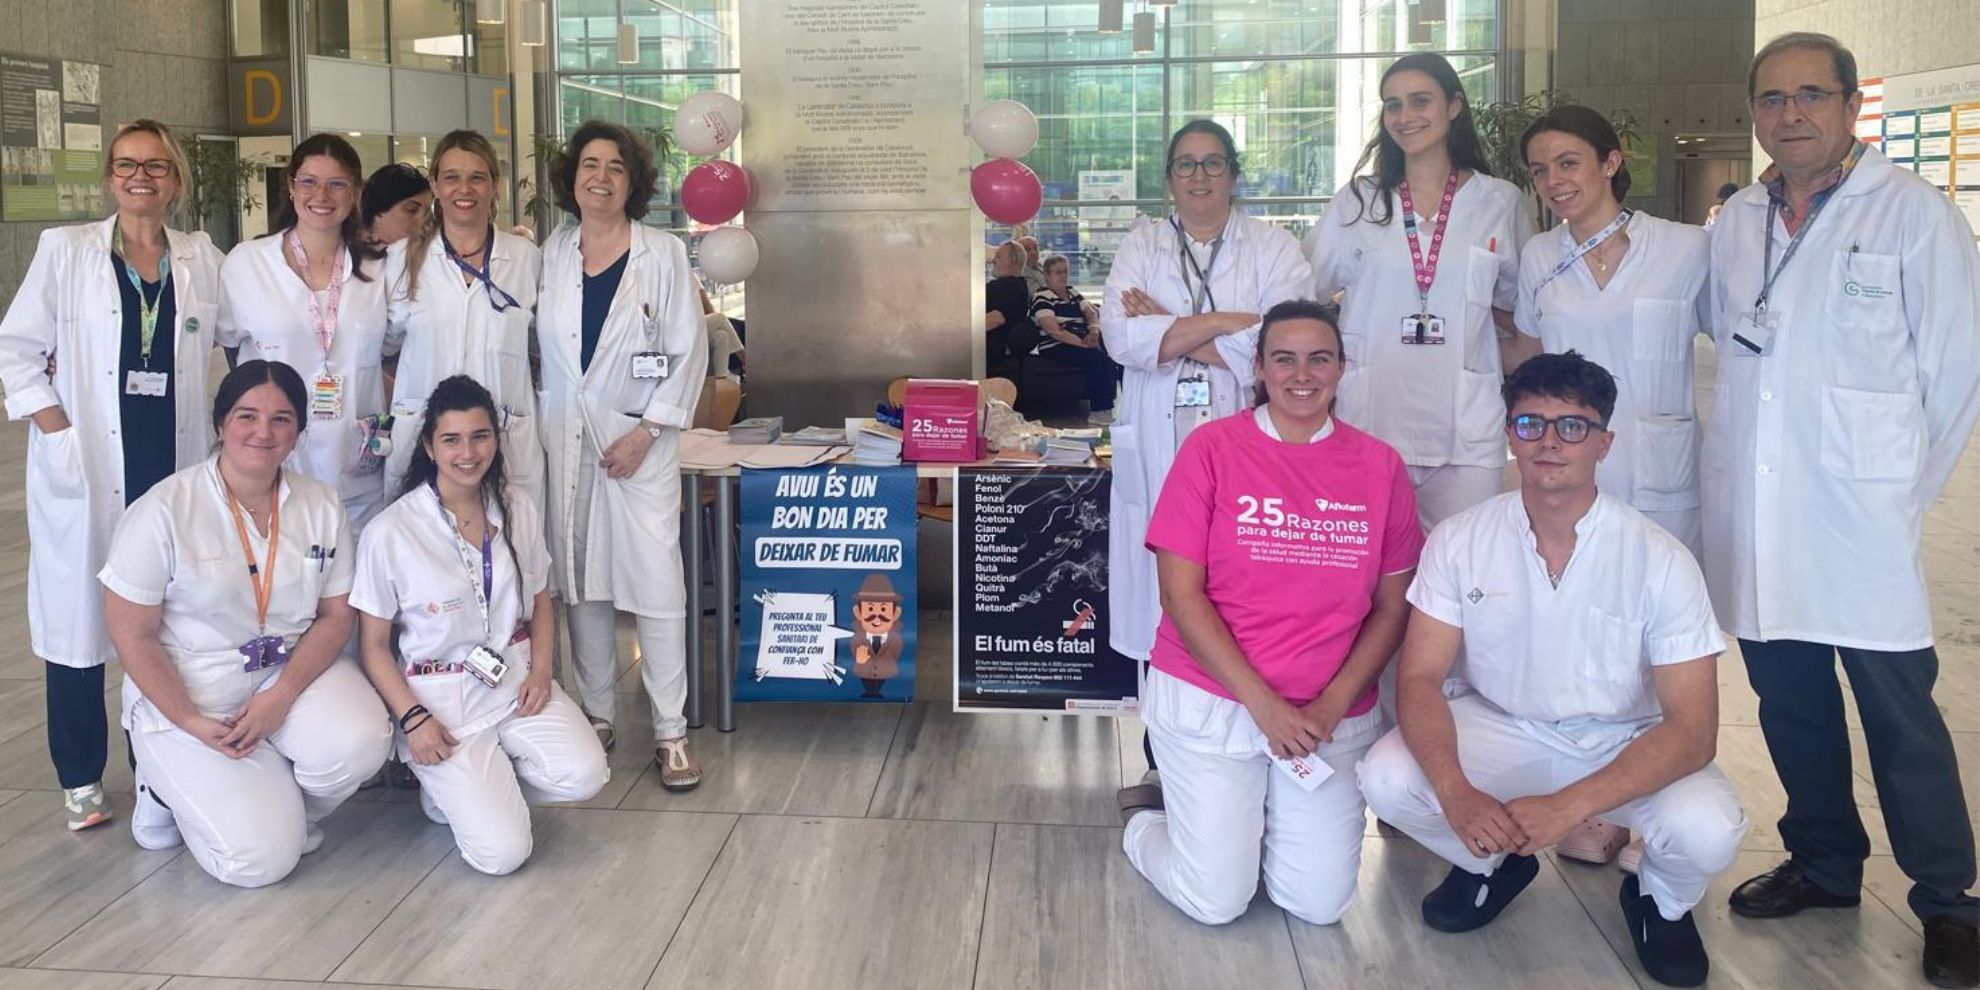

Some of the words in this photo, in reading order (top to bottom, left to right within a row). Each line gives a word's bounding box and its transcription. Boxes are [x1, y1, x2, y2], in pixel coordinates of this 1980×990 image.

[244, 68, 282, 126] D
[912, 418, 933, 432] 25
[933, 425, 968, 434] Razones
[776, 475, 820, 498] AVUI
[824, 467, 847, 498] ÉS
[850, 474, 878, 497] UN
[975, 474, 1012, 484] Arsènic
[975, 484, 1002, 493] Fenol
[975, 504, 1005, 513] Poloni
[1007, 504, 1024, 514] 210
[1237, 495, 1285, 527] 25
[771, 506, 814, 529] BON
[816, 507, 848, 529] DIA
[852, 507, 888, 529] PER
[975, 515, 1015, 524] Acetona
[1286, 513, 1369, 533] Razones
[975, 524, 1007, 533] Cianur
[975, 534, 996, 543] DDT
[1237, 526, 1267, 536] para
[1271, 528, 1305, 541] dejar
[1310, 531, 1326, 542] de
[1330, 533, 1369, 545] fumar
[975, 544, 1018, 553] Naftalina
[1271, 541, 1310, 550] informativa
[1311, 544, 1327, 552] para
[759, 542, 817, 562] DEIXAR
[819, 543, 840, 562] DE
[843, 544, 900, 563] FUMAR
[1269, 548, 1287, 556] salud
[1289, 549, 1322, 558] mediante
[975, 554, 1018, 563] Amoniac
[1299, 557, 1321, 567] ayuda
[1321, 559, 1358, 569] profesional
[975, 564, 998, 573] Butà
[975, 573, 1015, 583] Nicotina
[975, 583, 1005, 593] Quitrà
[975, 593, 1000, 602] Plom
[975, 603, 1015, 613] Metanol
[769, 612, 804, 621] PREGUNTA
[805, 612, 814, 621] AL
[815, 612, 827, 621] TEU
[773, 623, 822, 632] PROFESSIONAL
[777, 635, 809, 643] SANITARI
[809, 635, 818, 643] DE
[975, 635, 992, 651] El
[995, 635, 1030, 651] fum
[1033, 635, 1054, 653] és
[1057, 638, 1095, 654] fatal
[768, 645, 805, 656] CONFIANÇA
[807, 645, 824, 655] COM
[783, 656, 809, 665] FER-HO
[1291, 764, 1311, 779] 25
